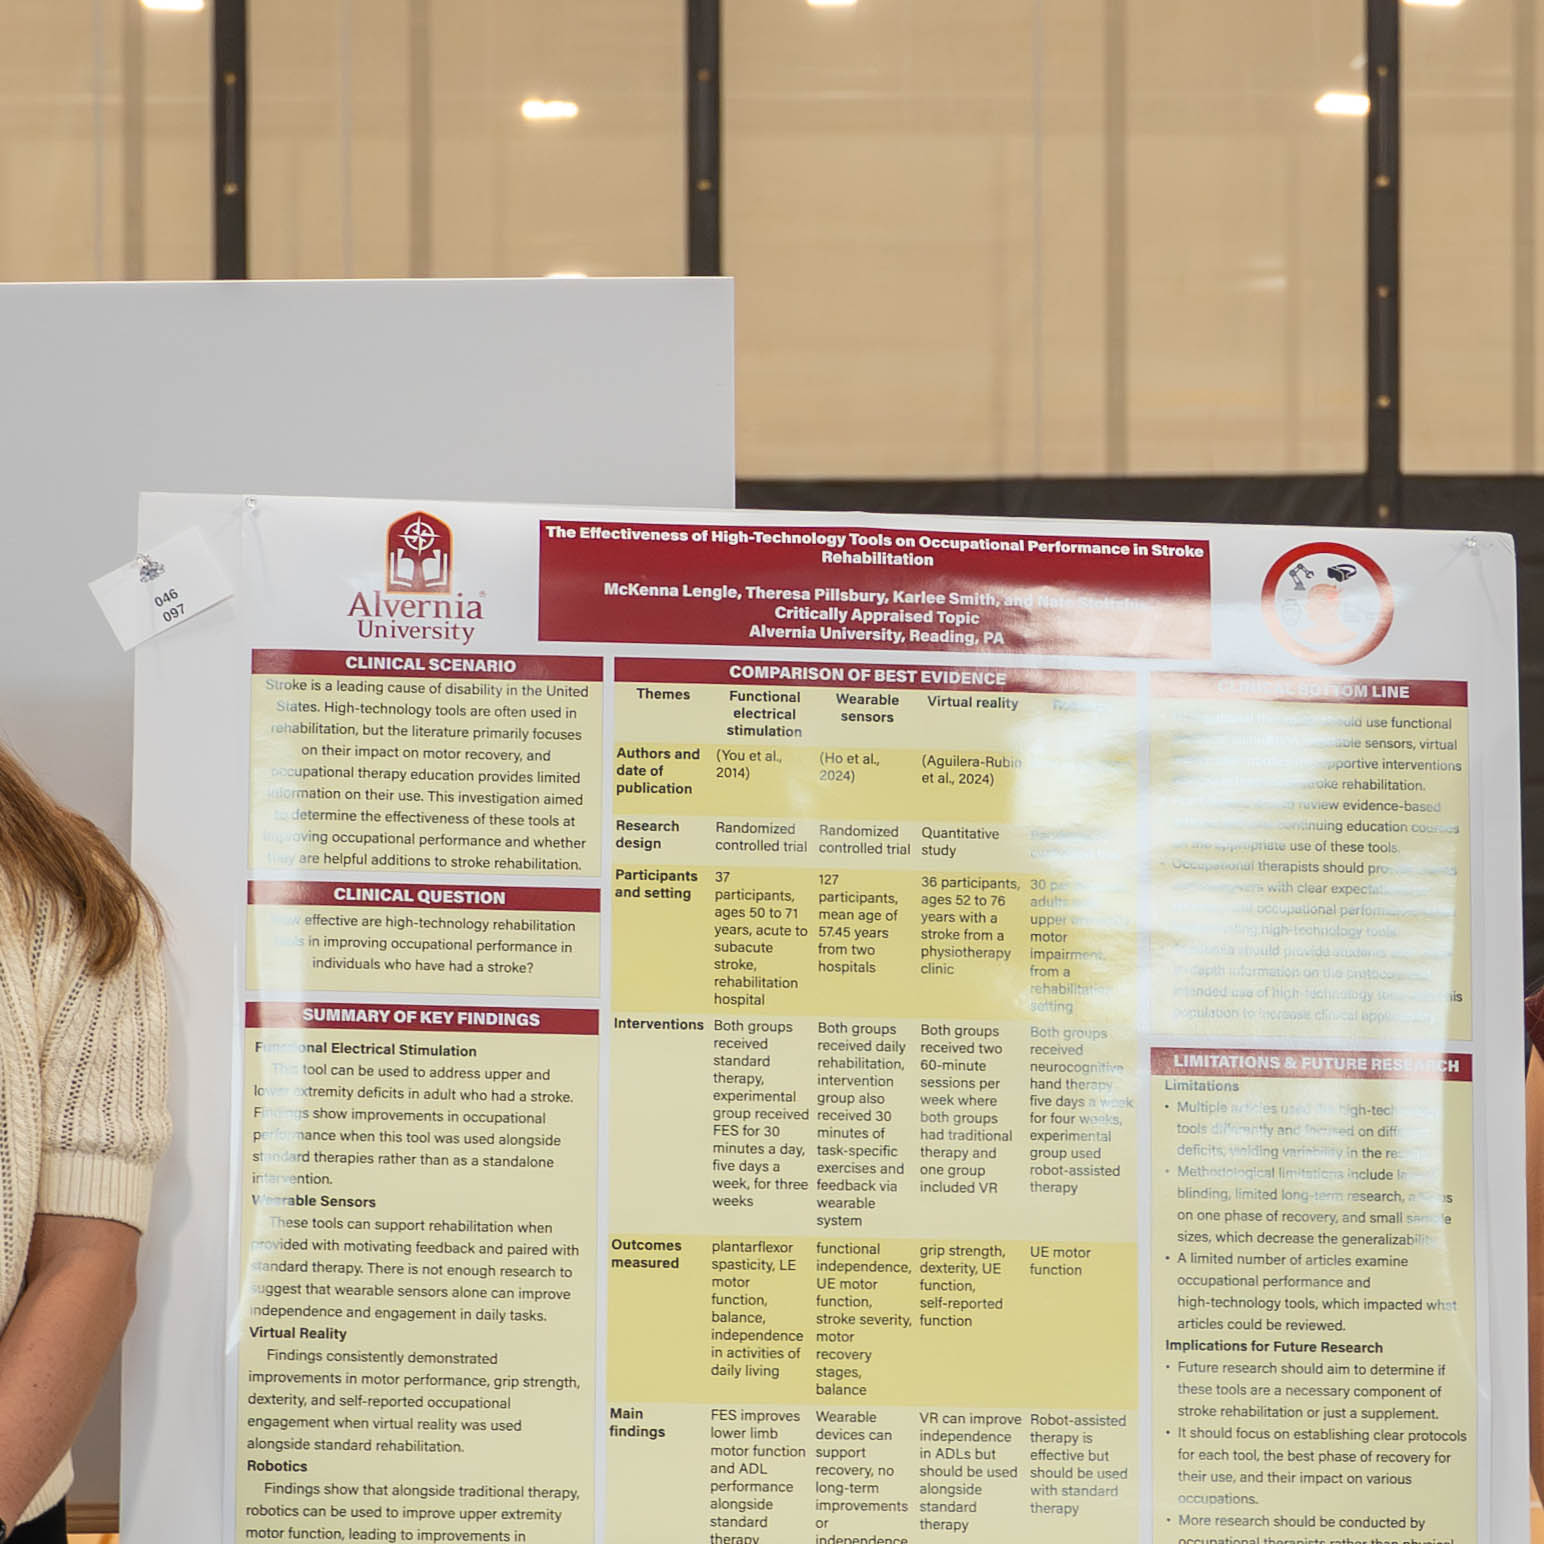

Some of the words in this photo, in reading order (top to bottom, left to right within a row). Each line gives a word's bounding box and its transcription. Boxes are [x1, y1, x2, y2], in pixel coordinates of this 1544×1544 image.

[545, 526, 576, 539] The
[580, 527, 689, 542] Effectiveness
[692, 528, 708, 541] of
[711, 530, 846, 548] High-Technology
[849, 533, 892, 547] Tools
[896, 538, 915, 548] on
[919, 536, 1024, 553] Occupational
[1028, 540, 1130, 555] Performance
[1134, 544, 1148, 556] in
[1151, 544, 1204, 558] Stroke
[822, 551, 934, 566] Rehabilitation
[154, 588, 179, 608] 046
[604, 582, 678, 596] McKenna
[682, 585, 743, 601] Lengle,
[746, 587, 810, 600] Theresa
[814, 588, 890, 605] Pillsbury,
[893, 591, 946, 604] Karlee
[949, 592, 999, 607] Smith,
[162, 603, 186, 622] 097
[347, 591, 484, 622] Alvernia
[774, 606, 848, 623] Critically
[851, 608, 933, 625] Appraised
[937, 610, 981, 626] Topic
[357, 620, 475, 645] University
[749, 625, 816, 639] Alvernia
[820, 627, 906, 644] University,
[909, 630, 979, 646] Reading,
[983, 632, 1005, 645] PA
[345, 656, 425, 671] CLINICAL
[428, 658, 517, 673] SCENARIO
[729, 665, 844, 681] COMPARISON
[848, 667, 871, 682] OF
[874, 668, 916, 683] BEST
[921, 669, 1006, 685] EVIDENCE
[265, 679, 307, 690] Stroke
[312, 680, 321, 691] is
[325, 683, 333, 692] a
[337, 680, 383, 695] leading
[388, 684, 425, 693] cause
[429, 682, 442, 694] of
[445, 683, 502, 698] disability
[507, 685, 517, 695] in
[522, 685, 542, 696] the
[547, 686, 589, 698] United
[637, 688, 691, 701] Themes
[1372, 684, 1410, 699] LINE
[729, 690, 801, 703] Functional
[836, 693, 899, 706] Wearable
[927, 696, 972, 709] Virtual
[976, 697, 1018, 711] reality
[733, 707, 796, 720] electrical
[841, 711, 894, 723] sensors
[727, 724, 803, 738] stimulation
[617, 747, 670, 760] Authors
[675, 748, 701, 760] and
[716, 749, 745, 763] (You
[749, 752, 761, 762] et
[617, 764, 646, 776] date
[650, 765, 664, 777] of
[716, 767, 750, 781] 2014)
[616, 782, 693, 796] publication
[616, 820, 679, 833] Research
[616, 837, 661, 852] design
[615, 869, 698, 884] Participants
[715, 872, 730, 883] 37
[819, 874, 839, 885] 127
[333, 887, 414, 902] CLINICAL
[418, 889, 506, 905] QUESTION
[615, 886, 640, 898] and
[644, 887, 691, 902] setting
[715, 889, 795, 904] participants,
[715, 908, 746, 921] ages
[750, 907, 765, 918] 50
[769, 908, 782, 919] to
[786, 908, 798, 919] 71
[818, 926, 850, 938] 57.45
[854, 928, 889, 941] years
[312, 957, 380, 970] individuals
[384, 959, 412, 971] who
[416, 960, 444, 972] have
[449, 961, 472, 972] had
[476, 964, 484, 973] a
[488, 962, 534, 974] stroke?
[303, 1008, 390, 1023] SUMMARY
[394, 1010, 416, 1024] OF
[420, 1011, 454, 1025] KEY
[457, 1012, 541, 1027] FINDINGS
[614, 1018, 705, 1031] Interventions
[1173, 1055, 1281, 1071] LIMITATIONS
[1285, 1058, 1298, 1071] &
[1302, 1058, 1367, 1071] FUTURE
[1165, 1080, 1240, 1093] Limitations
[611, 1239, 682, 1252] Outcomes
[1030, 1246, 1049, 1258] UE
[1053, 1248, 1092, 1259] motor
[611, 1256, 680, 1269] measured
[1030, 1263, 1083, 1276] function
[1177, 1318, 1224, 1331] articles
[1227, 1318, 1262, 1331] could
[1266, 1319, 1282, 1331] be
[1286, 1319, 1346, 1332] reviewed.
[249, 1326, 295, 1339] Virtual
[300, 1328, 347, 1343] Reality
[1165, 1339, 1248, 1354] Implications
[1250, 1340, 1270, 1353] for
[1274, 1341, 1317, 1353] Future
[1321, 1342, 1384, 1354] Research
[267, 1349, 323, 1364] Findings
[326, 1350, 404, 1366] consistently
[408, 1352, 499, 1365] demonstrated
[610, 1407, 644, 1420] Main
[711, 1409, 736, 1421] FES
[741, 1409, 801, 1424] improves
[816, 1411, 877, 1423] Wearable
[920, 1412, 938, 1424] VR
[942, 1415, 966, 1425] can
[970, 1413, 1022, 1427] improve
[1030, 1414, 1127, 1427] Robot-assisted
[609, 1425, 666, 1440] findings
[711, 1426, 747, 1439] lower
[751, 1427, 779, 1439] limb
[816, 1428, 865, 1441] devices
[869, 1431, 893, 1441] can
[920, 1430, 1012, 1444] independence
[1030, 1432, 1079, 1447] therapy
[1083, 1432, 1094, 1444] is
[816, 1447, 866, 1461] support
[920, 1448, 931, 1459] in
[935, 1448, 971, 1460] ADLs
[975, 1448, 996, 1460] but
[1030, 1448, 1085, 1461] effective
[1088, 1449, 1109, 1462] but
[247, 1459, 308, 1473] Robotics
[816, 1465, 874, 1480] recovery,
[878, 1467, 895, 1477] no
[264, 1482, 320, 1497] Findings
[324, 1483, 359, 1496] show
[363, 1484, 388, 1496] that
[392, 1484, 455, 1499] alongside
[459, 1486, 524, 1498] traditional
[528, 1487, 580, 1502] therapy,
[816, 1482, 879, 1496] long-term
[816, 1500, 909, 1514] improvements
